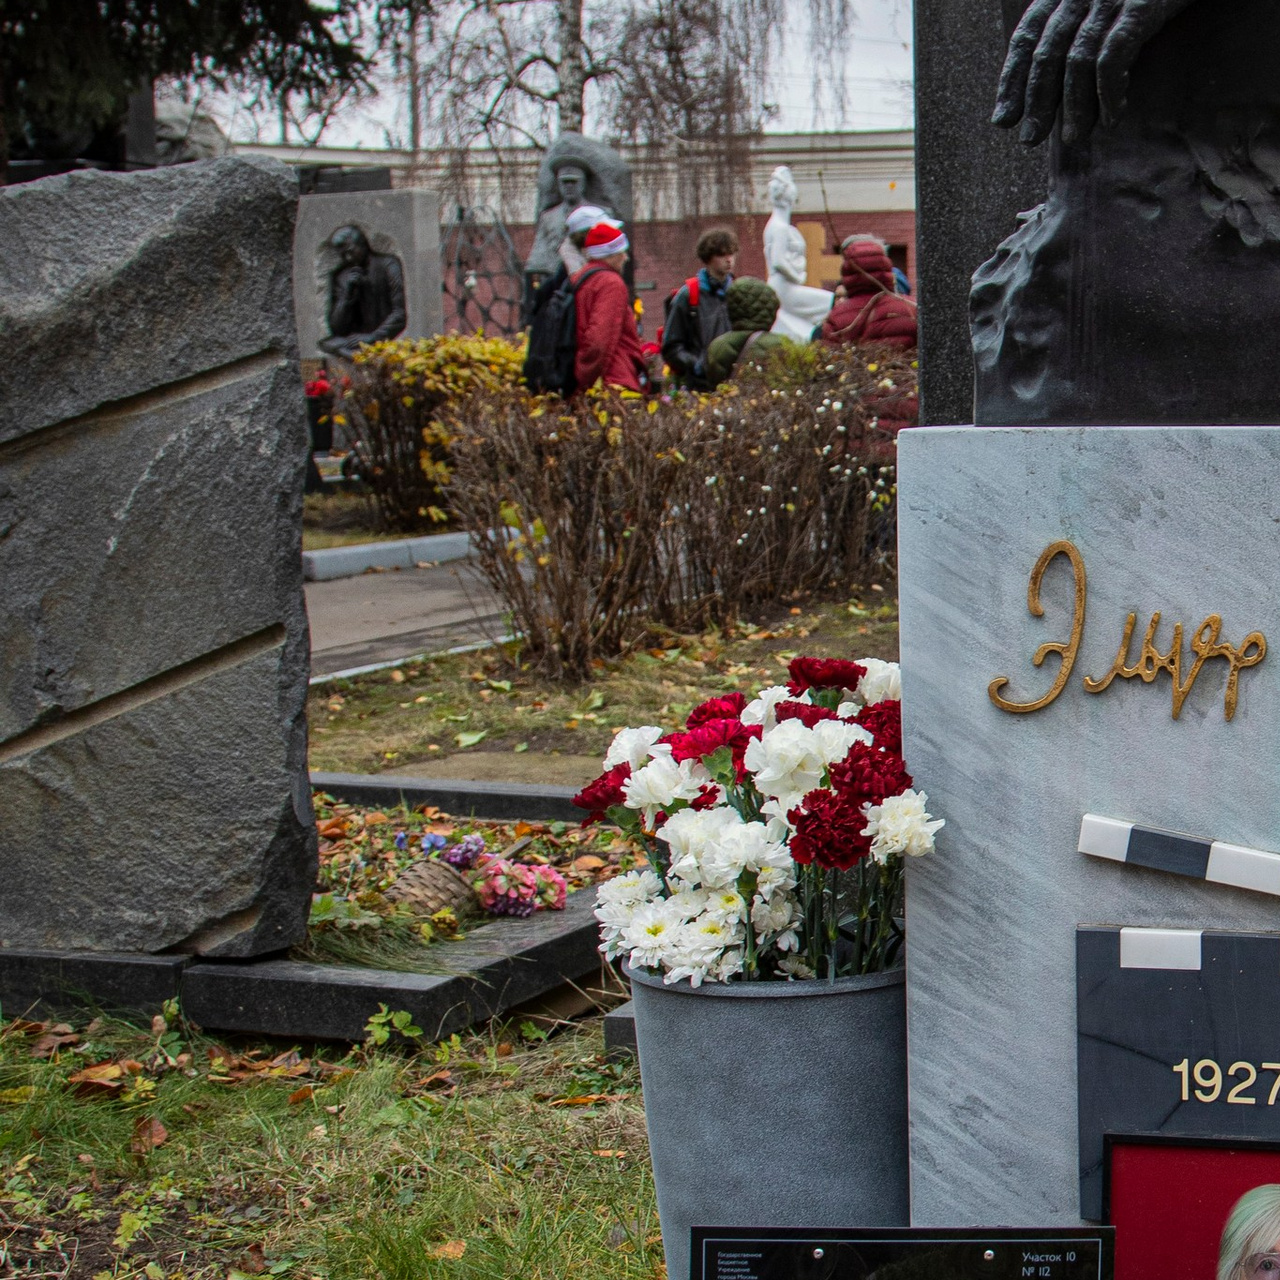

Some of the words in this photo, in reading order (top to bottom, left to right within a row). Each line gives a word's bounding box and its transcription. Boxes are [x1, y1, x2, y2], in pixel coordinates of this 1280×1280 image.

[1021, 1251, 1062, 1263] Участок
[1065, 1251, 1077, 1262] 10
[1021, 1266, 1036, 1277] №
[1038, 1266, 1051, 1277] 112
